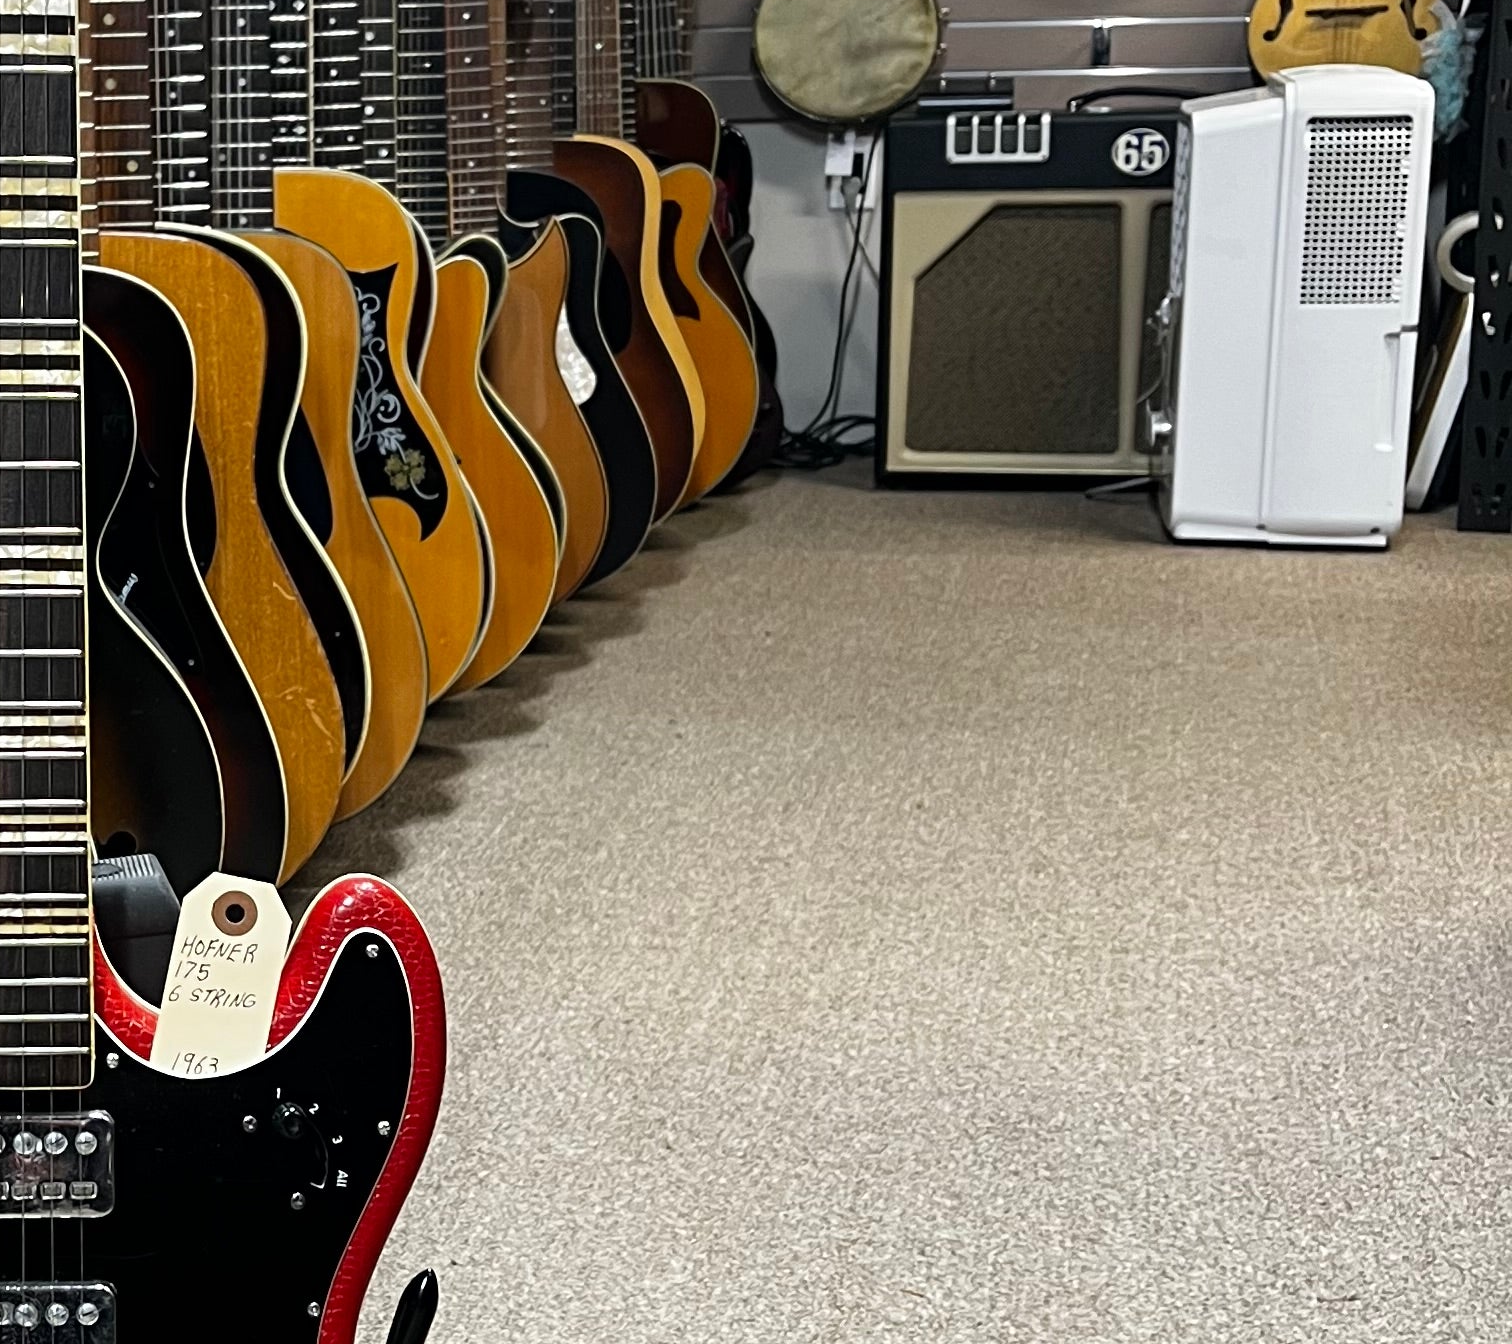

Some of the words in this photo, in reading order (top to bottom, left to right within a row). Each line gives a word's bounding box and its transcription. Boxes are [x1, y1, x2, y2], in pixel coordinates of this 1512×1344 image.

[1116, 133, 1164, 173] 65
[180, 934, 259, 964] HOFNER
[174, 960, 212, 982] 175
[168, 984, 183, 1002] 6
[189, 987, 257, 1009] STRING
[171, 1051, 220, 1075] 1963
[276, 1087, 282, 1100] 1
[308, 1102, 320, 1115] 2
[331, 1135, 343, 1145] 3
[335, 1169, 349, 1188] All
